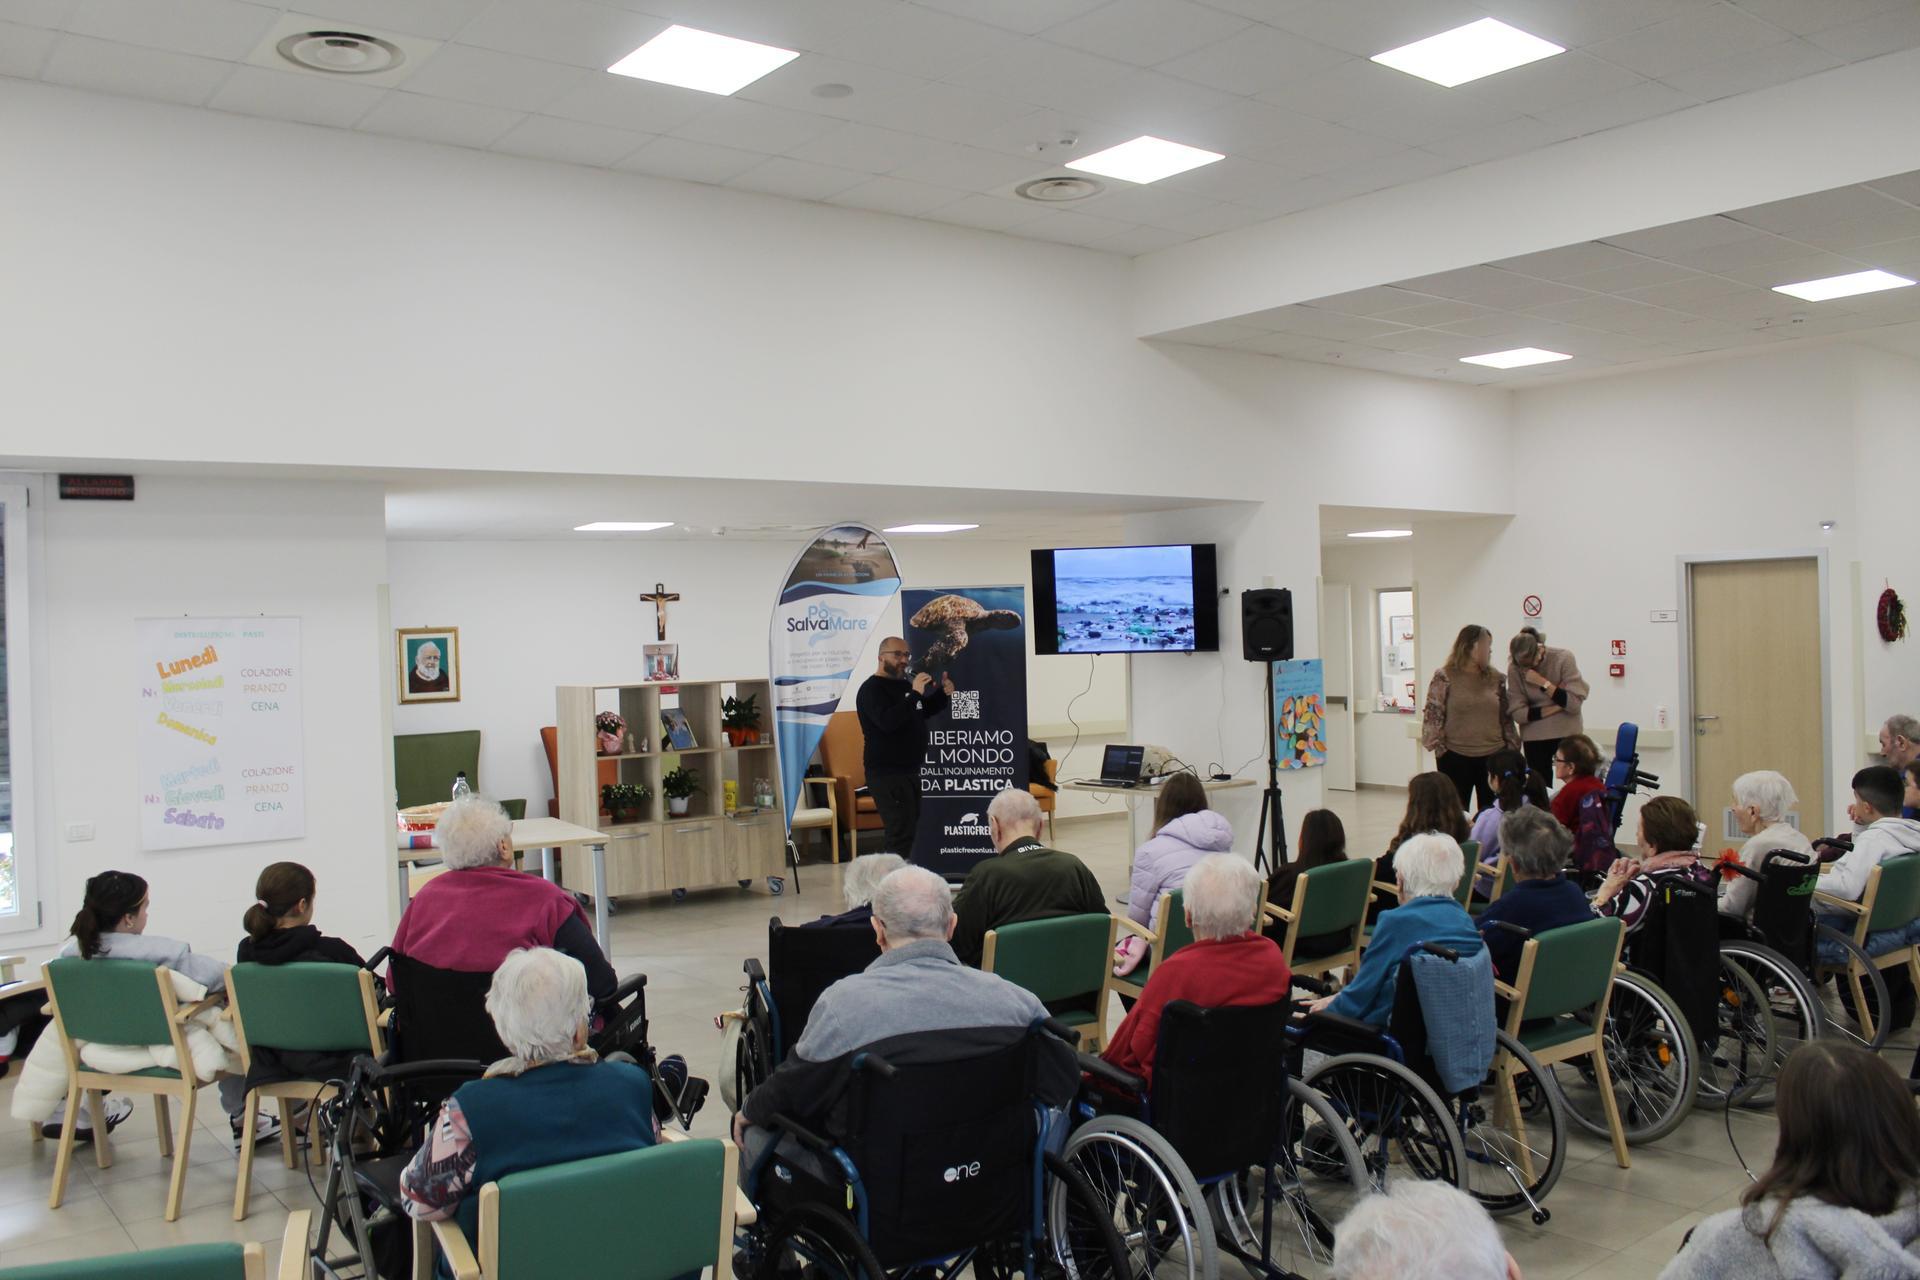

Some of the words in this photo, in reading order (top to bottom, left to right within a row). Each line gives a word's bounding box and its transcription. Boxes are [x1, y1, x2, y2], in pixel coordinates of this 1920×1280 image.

[787, 616, 868, 632] SalvaMare
[240, 667, 294, 677] COLAZIONE
[243, 683, 287, 693] PRANZO
[250, 701, 280, 711] CENA
[928, 730, 1014, 745] IBERIAMO
[940, 748, 1014, 764] MONDO
[241, 766, 295, 778] COLAZIONE
[920, 766, 1015, 776] DALL'INQUINAMENTO
[246, 783, 289, 794] PRANZO
[921, 779, 941, 791] DA
[944, 778, 1015, 791] PLASTICA
[254, 802, 284, 812] CENA
[163, 807, 225, 830] Sabato
